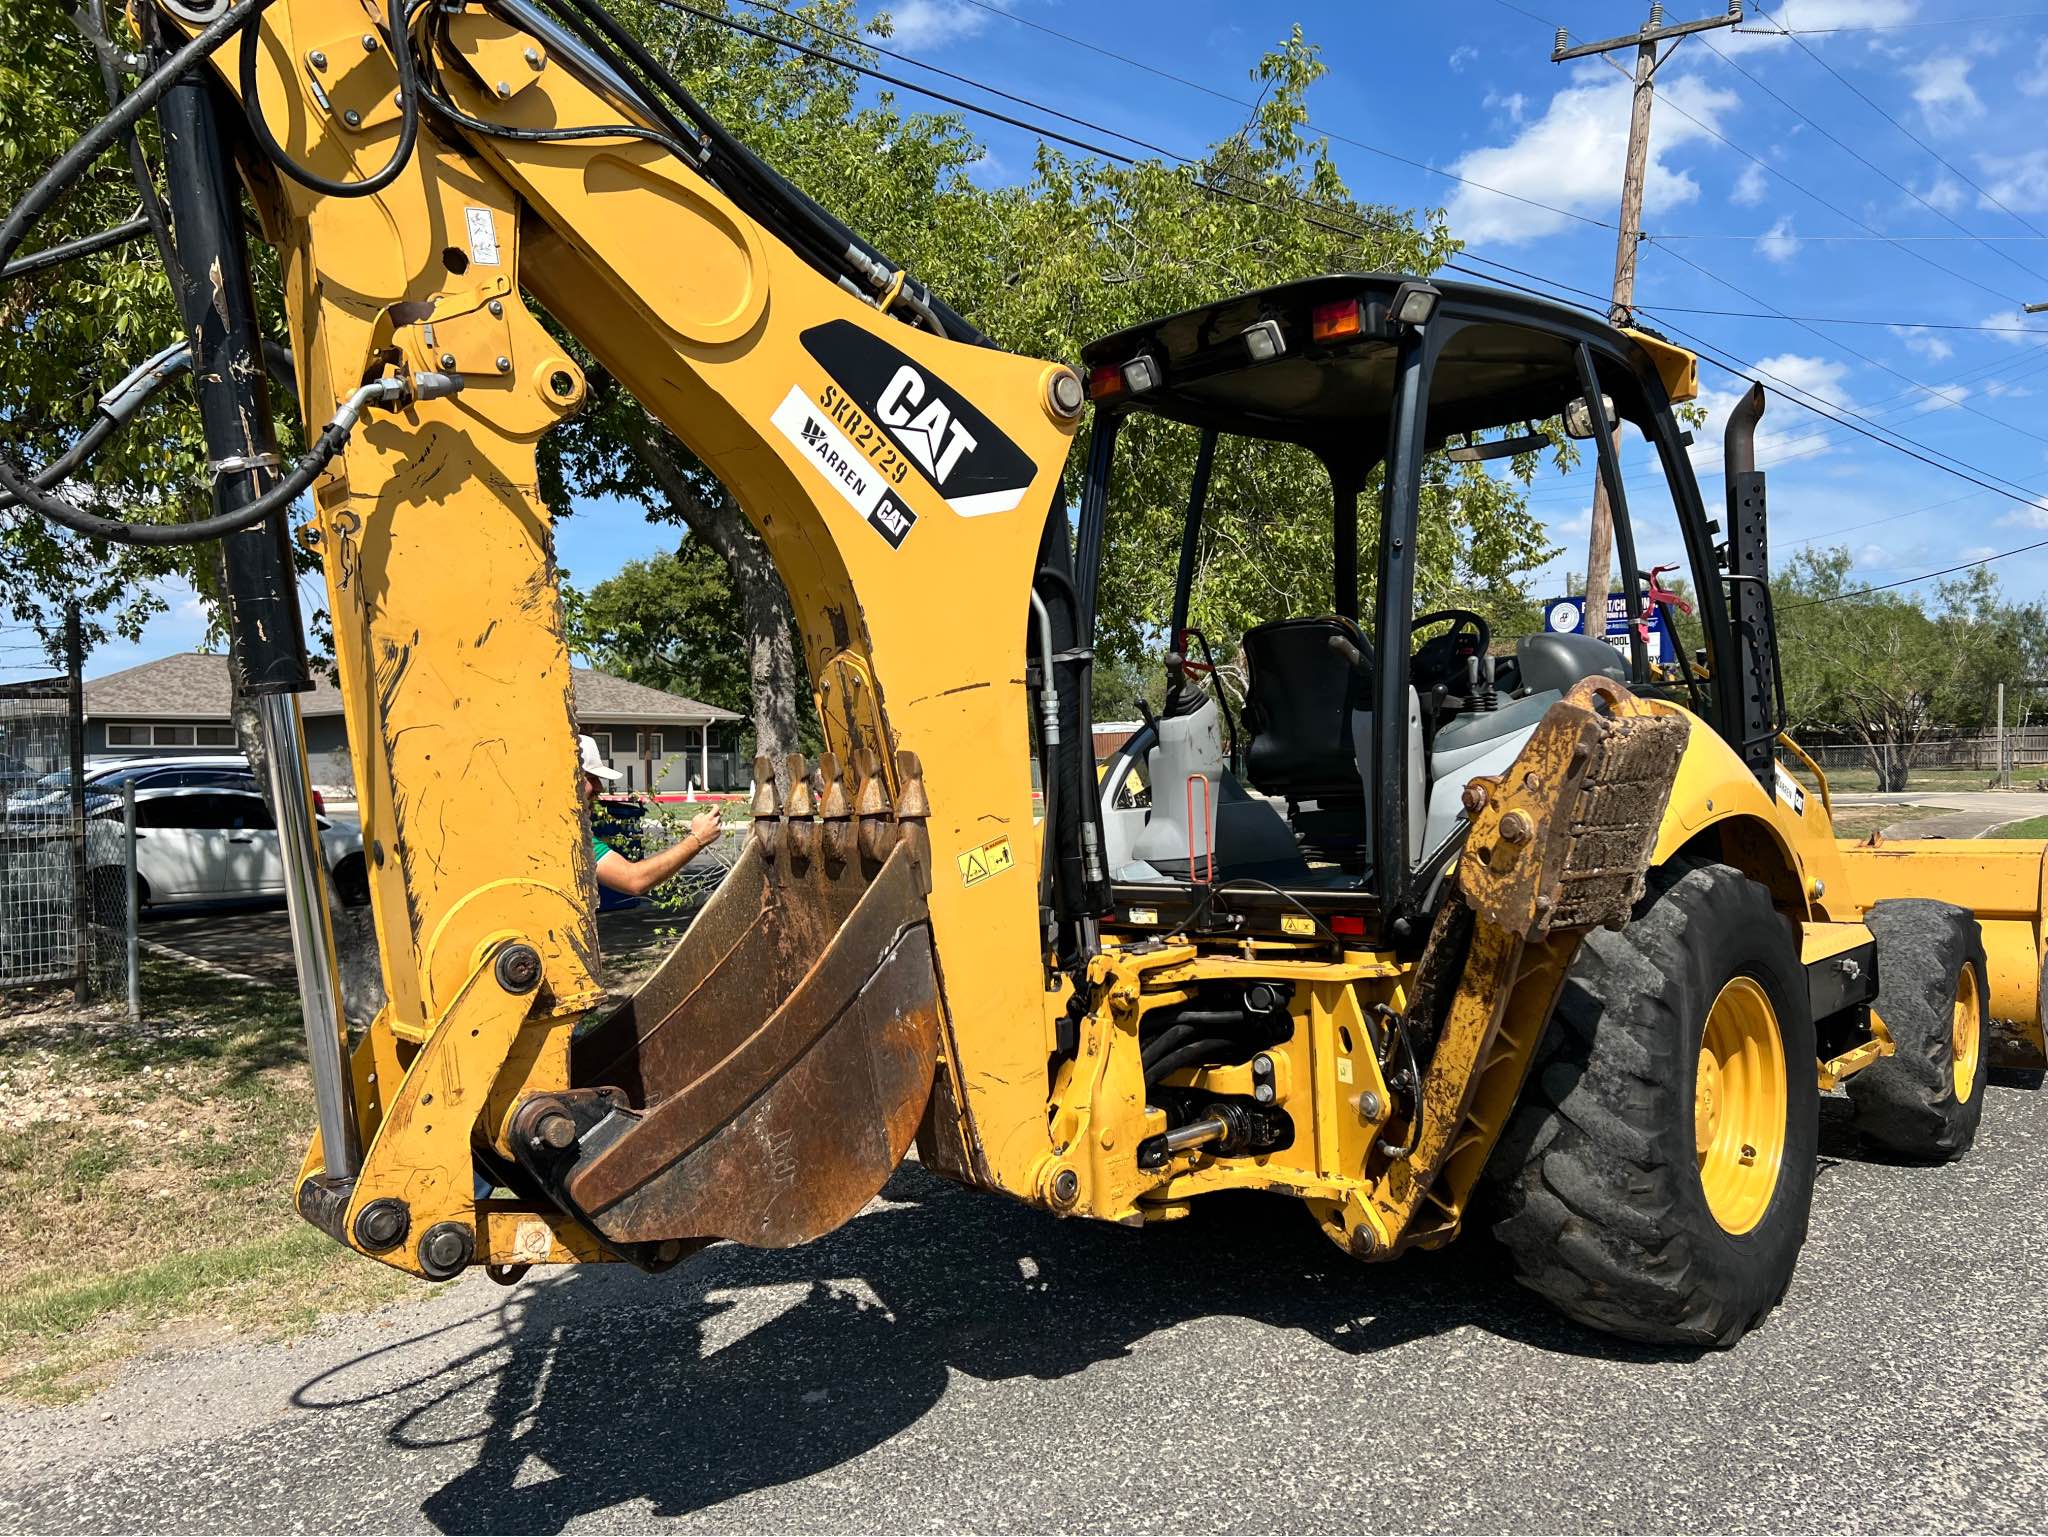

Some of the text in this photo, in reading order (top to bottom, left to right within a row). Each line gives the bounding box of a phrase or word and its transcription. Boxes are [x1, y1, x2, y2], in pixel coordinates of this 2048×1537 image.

[801, 416, 909, 537] WARREN CAT
[820, 385, 908, 484] SKR2729
[876, 365, 978, 486] CAT
[1609, 637, 1629, 645] HOOL
